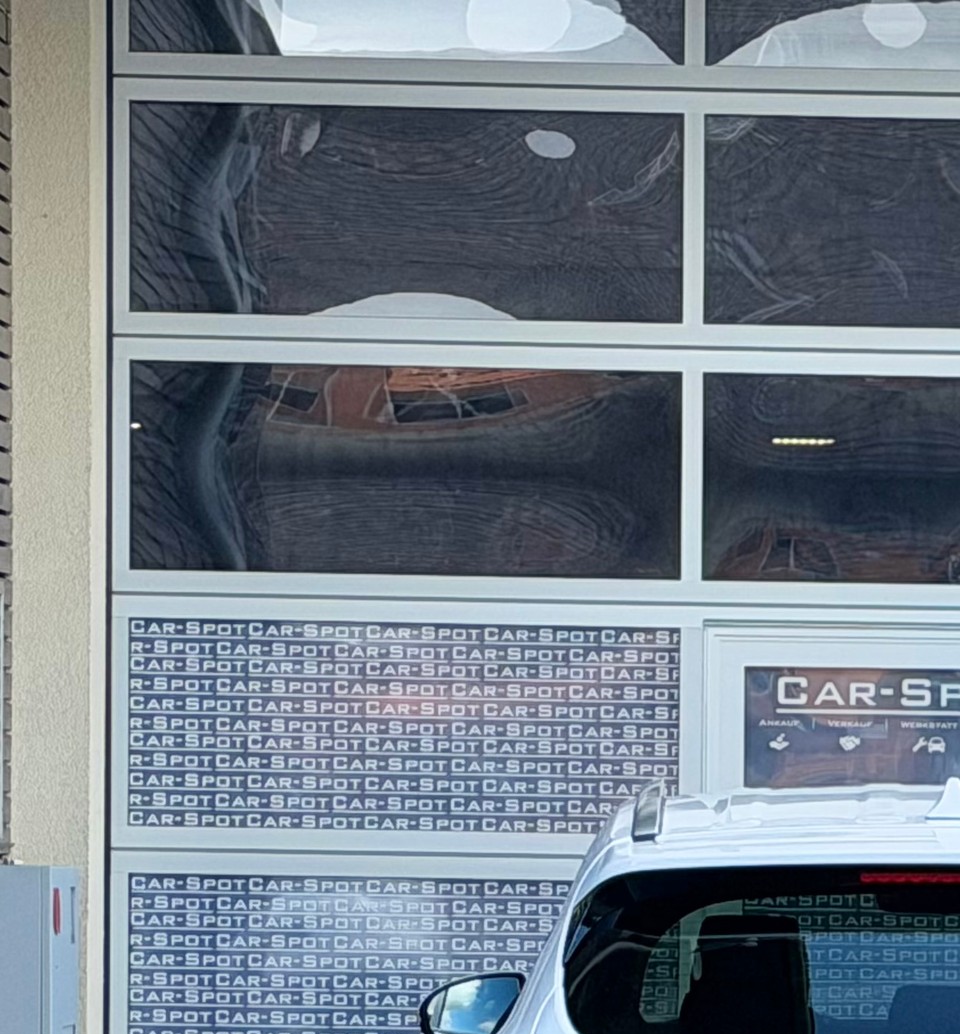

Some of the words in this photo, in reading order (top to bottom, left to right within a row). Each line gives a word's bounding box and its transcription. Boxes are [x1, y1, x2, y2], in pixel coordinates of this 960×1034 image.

[130, 620, 246, 635] CAR-SPOT
[248, 622, 363, 637] CAR-SPOT
[365, 624, 480, 640] CAR-SPOT
[482, 626, 597, 642] CAR-SPOT
[216, 640, 331, 657] CAR-SPOT
[333, 642, 449, 659] CAR-SPOT
[451, 644, 566, 661] CAR-SPOT
[130, 657, 246, 673] CAR-SPOT
[247, 659, 363, 675] CAR-SPOT
[365, 661, 480, 677] CAR-SPOT
[482, 663, 597, 679] CAR-SPOT
[215, 677, 331, 693] CAR-SPOT
[333, 679, 448, 695] CAR-SPOT
[450, 681, 565, 697] CAR-SPOT
[129, 695, 245, 711] CAR-SPOT
[247, 697, 363, 714] CAR-SPOT
[364, 699, 480, 716] CAR-SPOT
[481, 701, 596, 718] CAR-SPOT
[215, 716, 330, 732] CAR-SPOT
[332, 718, 448, 734] CAR-SPOT
[450, 720, 565, 736] CAR-SPOT
[129, 732, 245, 748] CAR-SPOT
[247, 734, 362, 750] CAR-SPOT
[364, 736, 479, 752] CAR-SPOT
[481, 738, 596, 754] CAR-SPOT
[214, 753, 330, 769] CAR-SPOT
[332, 755, 447, 771] CAR-SPOT
[449, 757, 565, 773] CAR-SPOT
[129, 771, 244, 788] CAR-SPOT
[246, 773, 362, 790] CAR-SPOT
[364, 775, 479, 792] CAR-SPOT
[481, 777, 596, 794] CAR-SPOT
[214, 792, 330, 809] CAR-SPOT
[332, 794, 447, 810] CAR-SPOT
[449, 796, 564, 812] CAR-SPOT
[128, 811, 244, 827] CAR-SPOT
[246, 813, 361, 829] CAR-SPOT
[363, 814, 479, 830] CAR-SPOT
[480, 816, 595, 832] CAR-SPOT
[130, 875, 246, 891] CAR-SPOT
[215, 896, 331, 912] CAR-SPOT
[130, 913, 246, 928] CAR-SPOT
[215, 932, 330, 949] CAR-SPOT
[130, 951, 245, 967] CAR-SPOT
[247, 953, 363, 969] CAR-SPOT
[365, 955, 480, 971] CAR-SPOT
[215, 972, 330, 988] CAR-SPOT
[129, 988, 245, 1004] CAR-SPOT
[247, 990, 363, 1006] CAR-SPOT
[214, 1009, 330, 1025] CAR-SPOT
